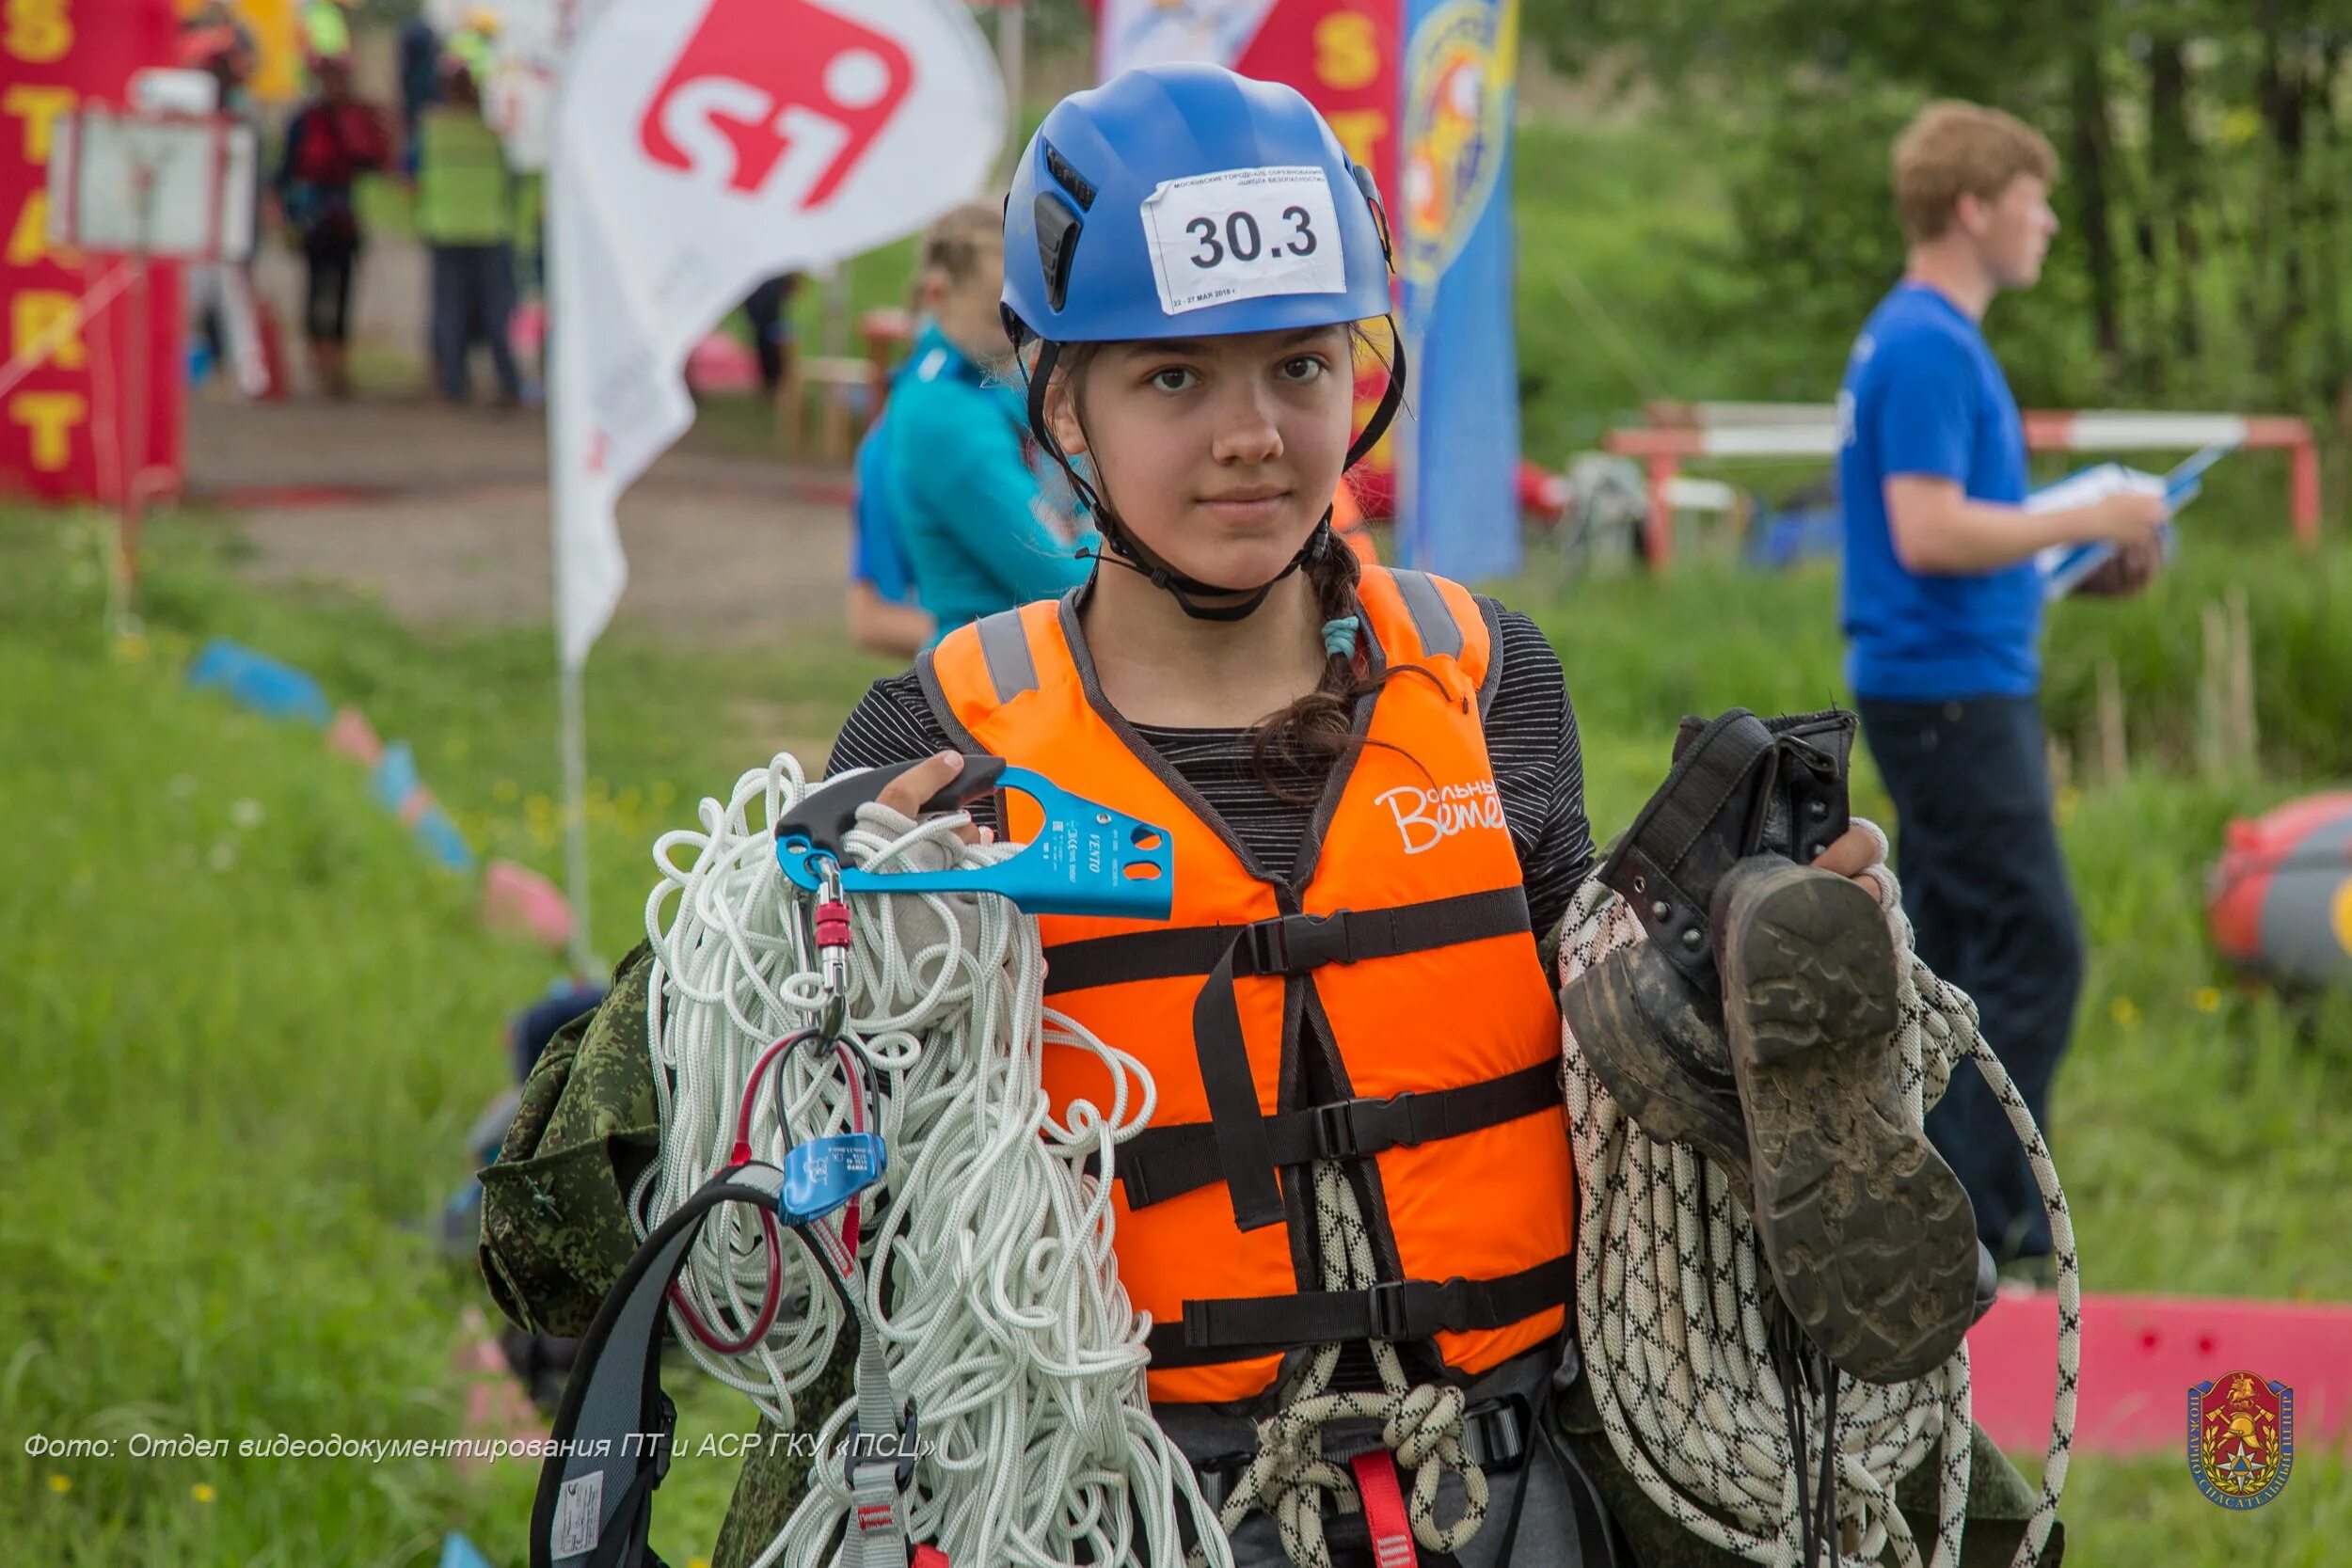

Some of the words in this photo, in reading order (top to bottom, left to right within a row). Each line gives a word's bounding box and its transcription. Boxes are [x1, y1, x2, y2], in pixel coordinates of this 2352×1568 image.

[1185, 205, 1317, 269] 30.3
[1197, 292, 1214, 301] МАЯ
[1089, 833, 1101, 873] VENTO
